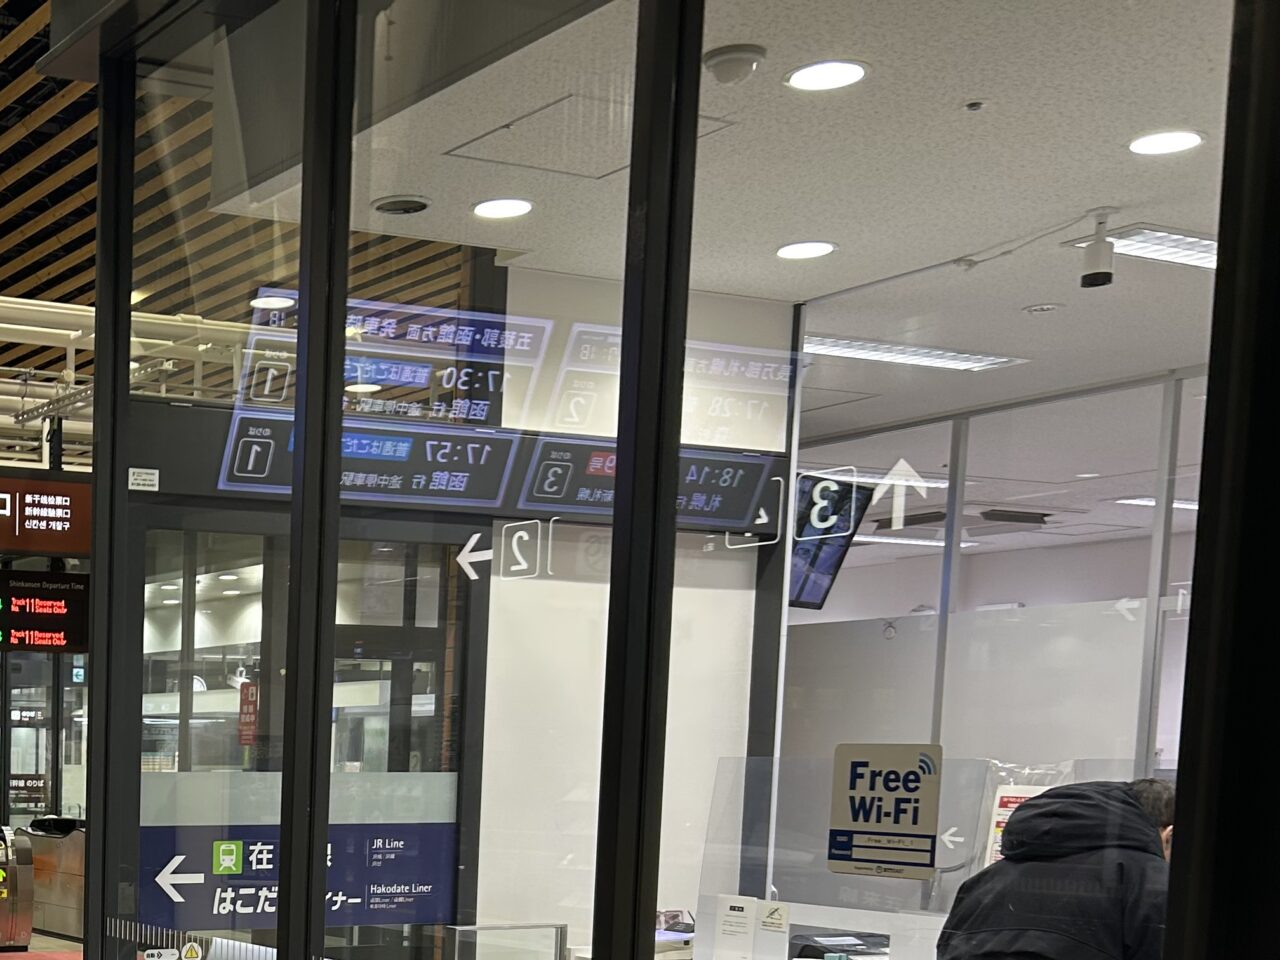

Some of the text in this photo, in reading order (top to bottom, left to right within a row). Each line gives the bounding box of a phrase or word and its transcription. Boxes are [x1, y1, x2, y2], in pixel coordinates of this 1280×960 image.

[25, 598, 34, 613] 11
[25, 630, 34, 645] 11
[849, 761, 920, 792] Free
[850, 795, 920, 826] Wi-Fi
[371, 838, 404, 849] JR Line
[370, 883, 432, 894] Hakodate Liner
